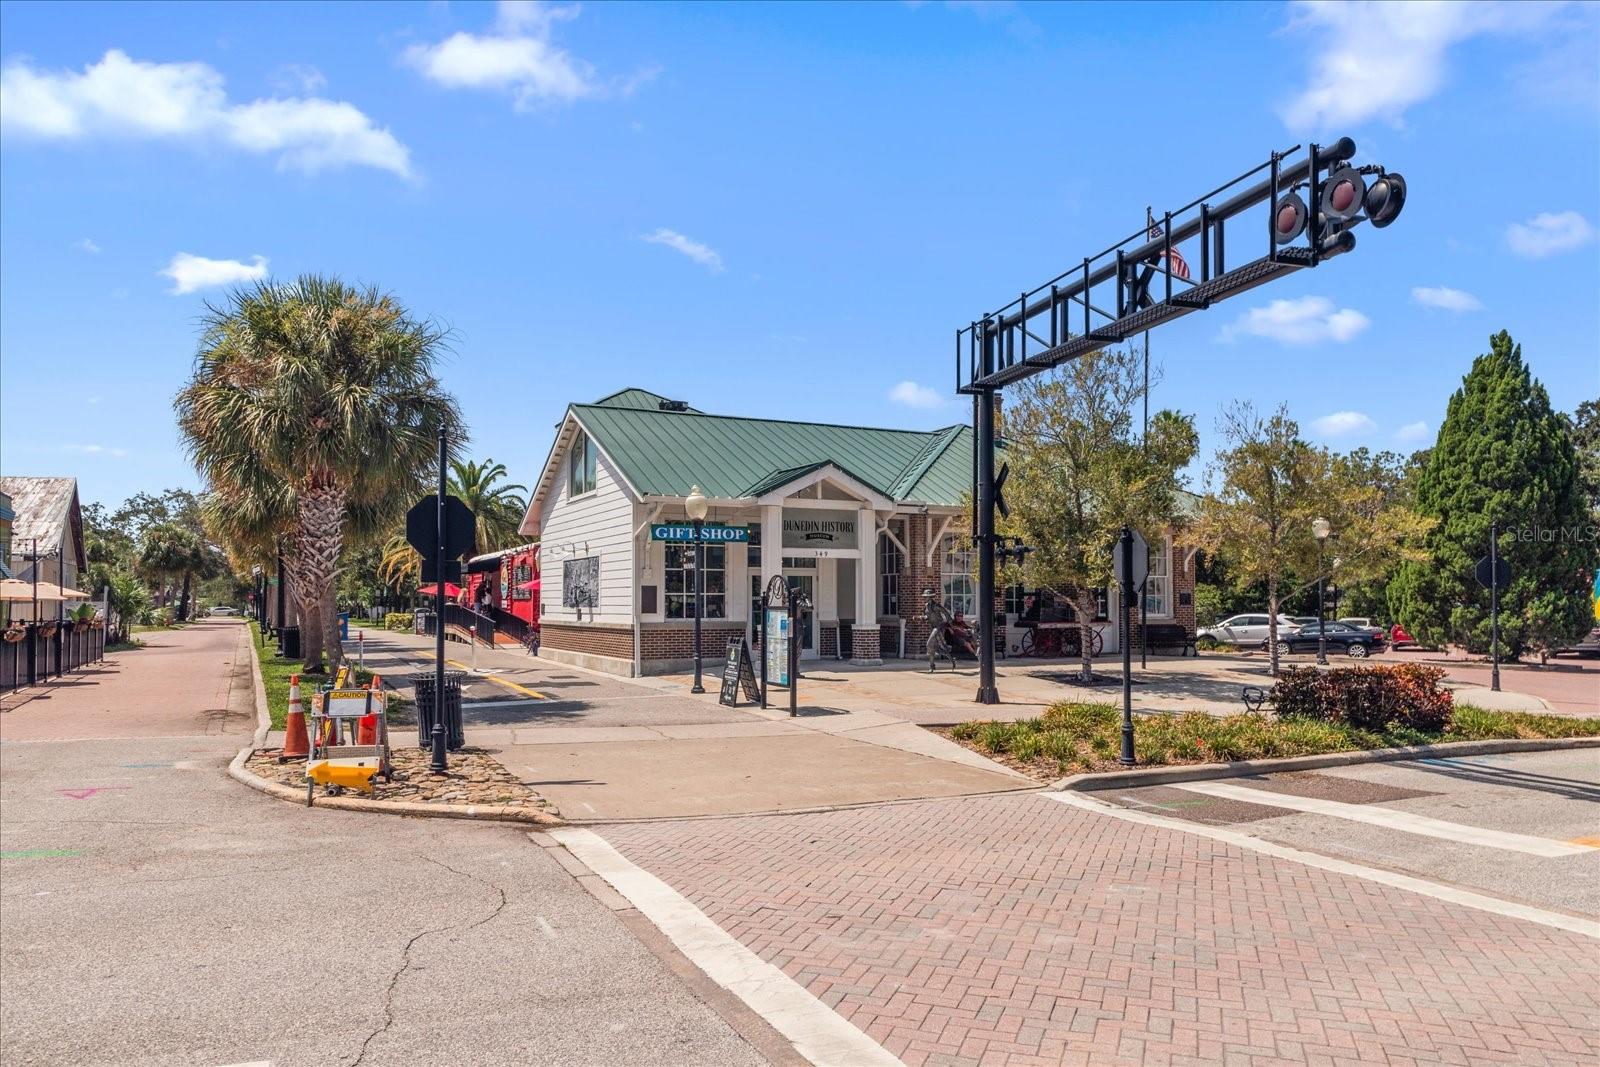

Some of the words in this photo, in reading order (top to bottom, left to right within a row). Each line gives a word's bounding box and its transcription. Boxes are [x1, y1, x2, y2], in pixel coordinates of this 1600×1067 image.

[784, 520, 819, 531] DUNEDIN
[822, 521, 855, 532] HISTORY
[655, 527, 695, 539] GIFT
[701, 528, 744, 540] SHOP
